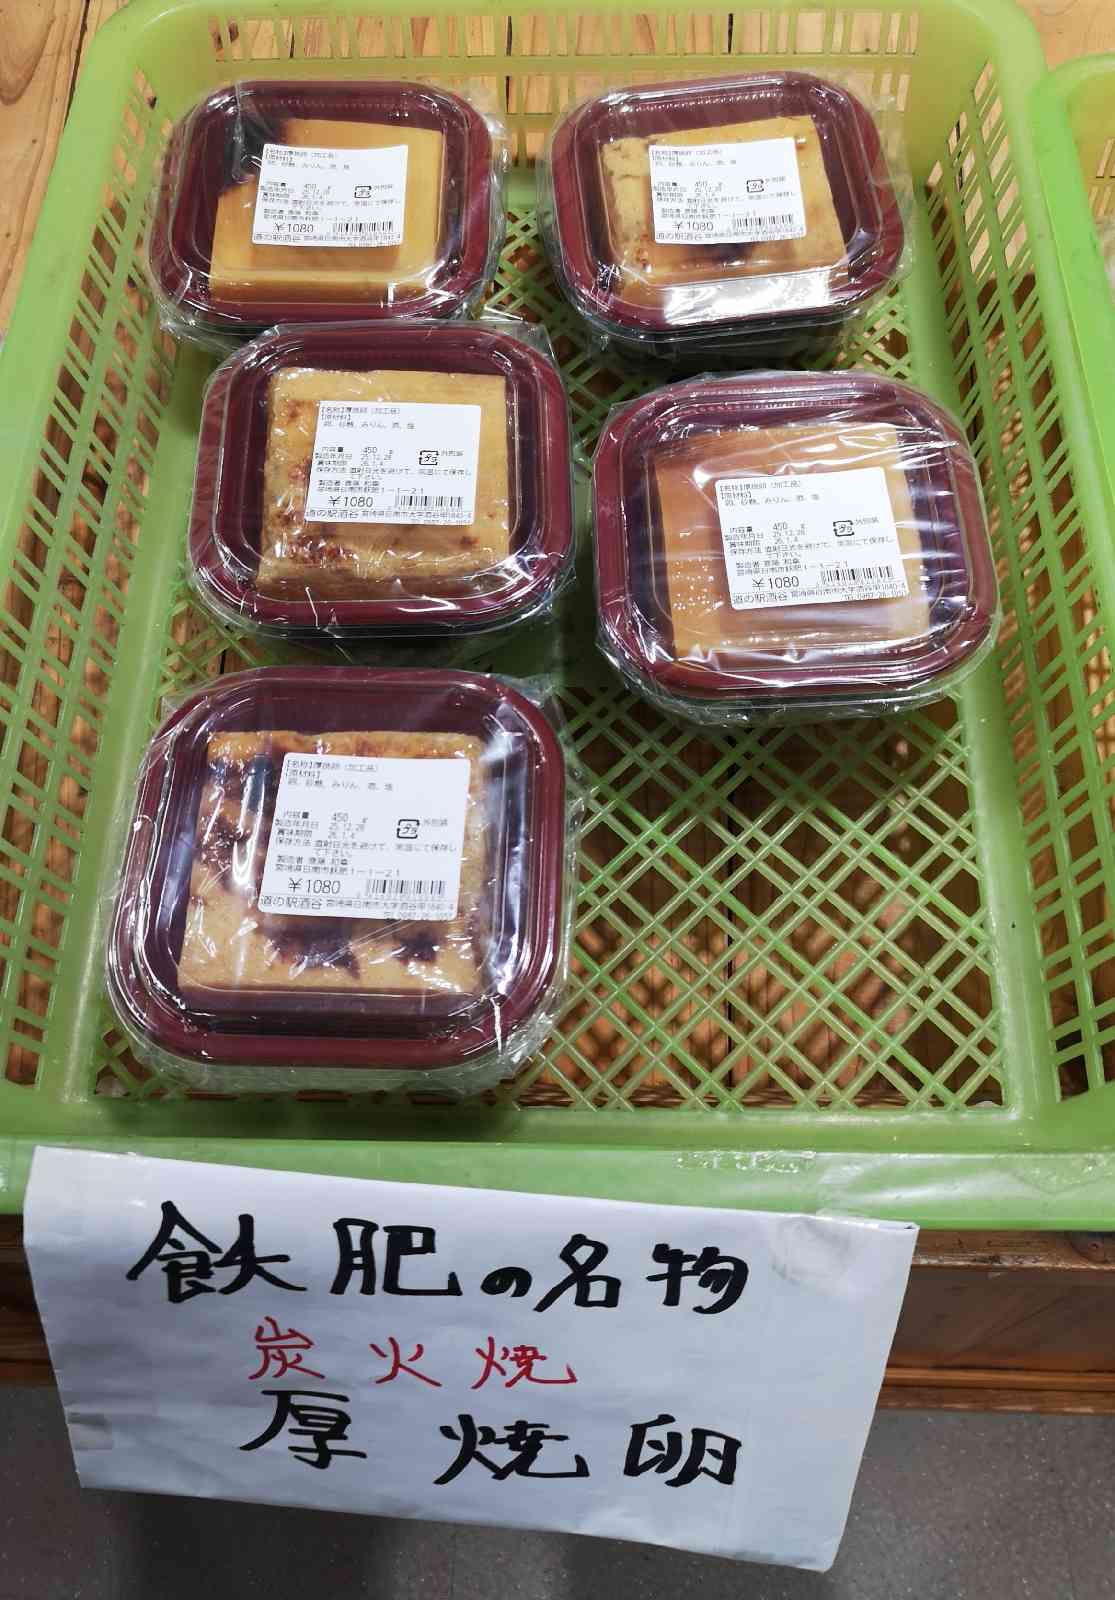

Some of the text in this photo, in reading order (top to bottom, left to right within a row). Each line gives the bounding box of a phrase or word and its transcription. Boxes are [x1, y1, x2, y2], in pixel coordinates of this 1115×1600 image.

[773, 522, 788, 530] 450
[332, 812, 349, 822] 450
[249, 1316, 577, 1389] 炭火焼
[240, 1390, 741, 1487] 厚焼卵
